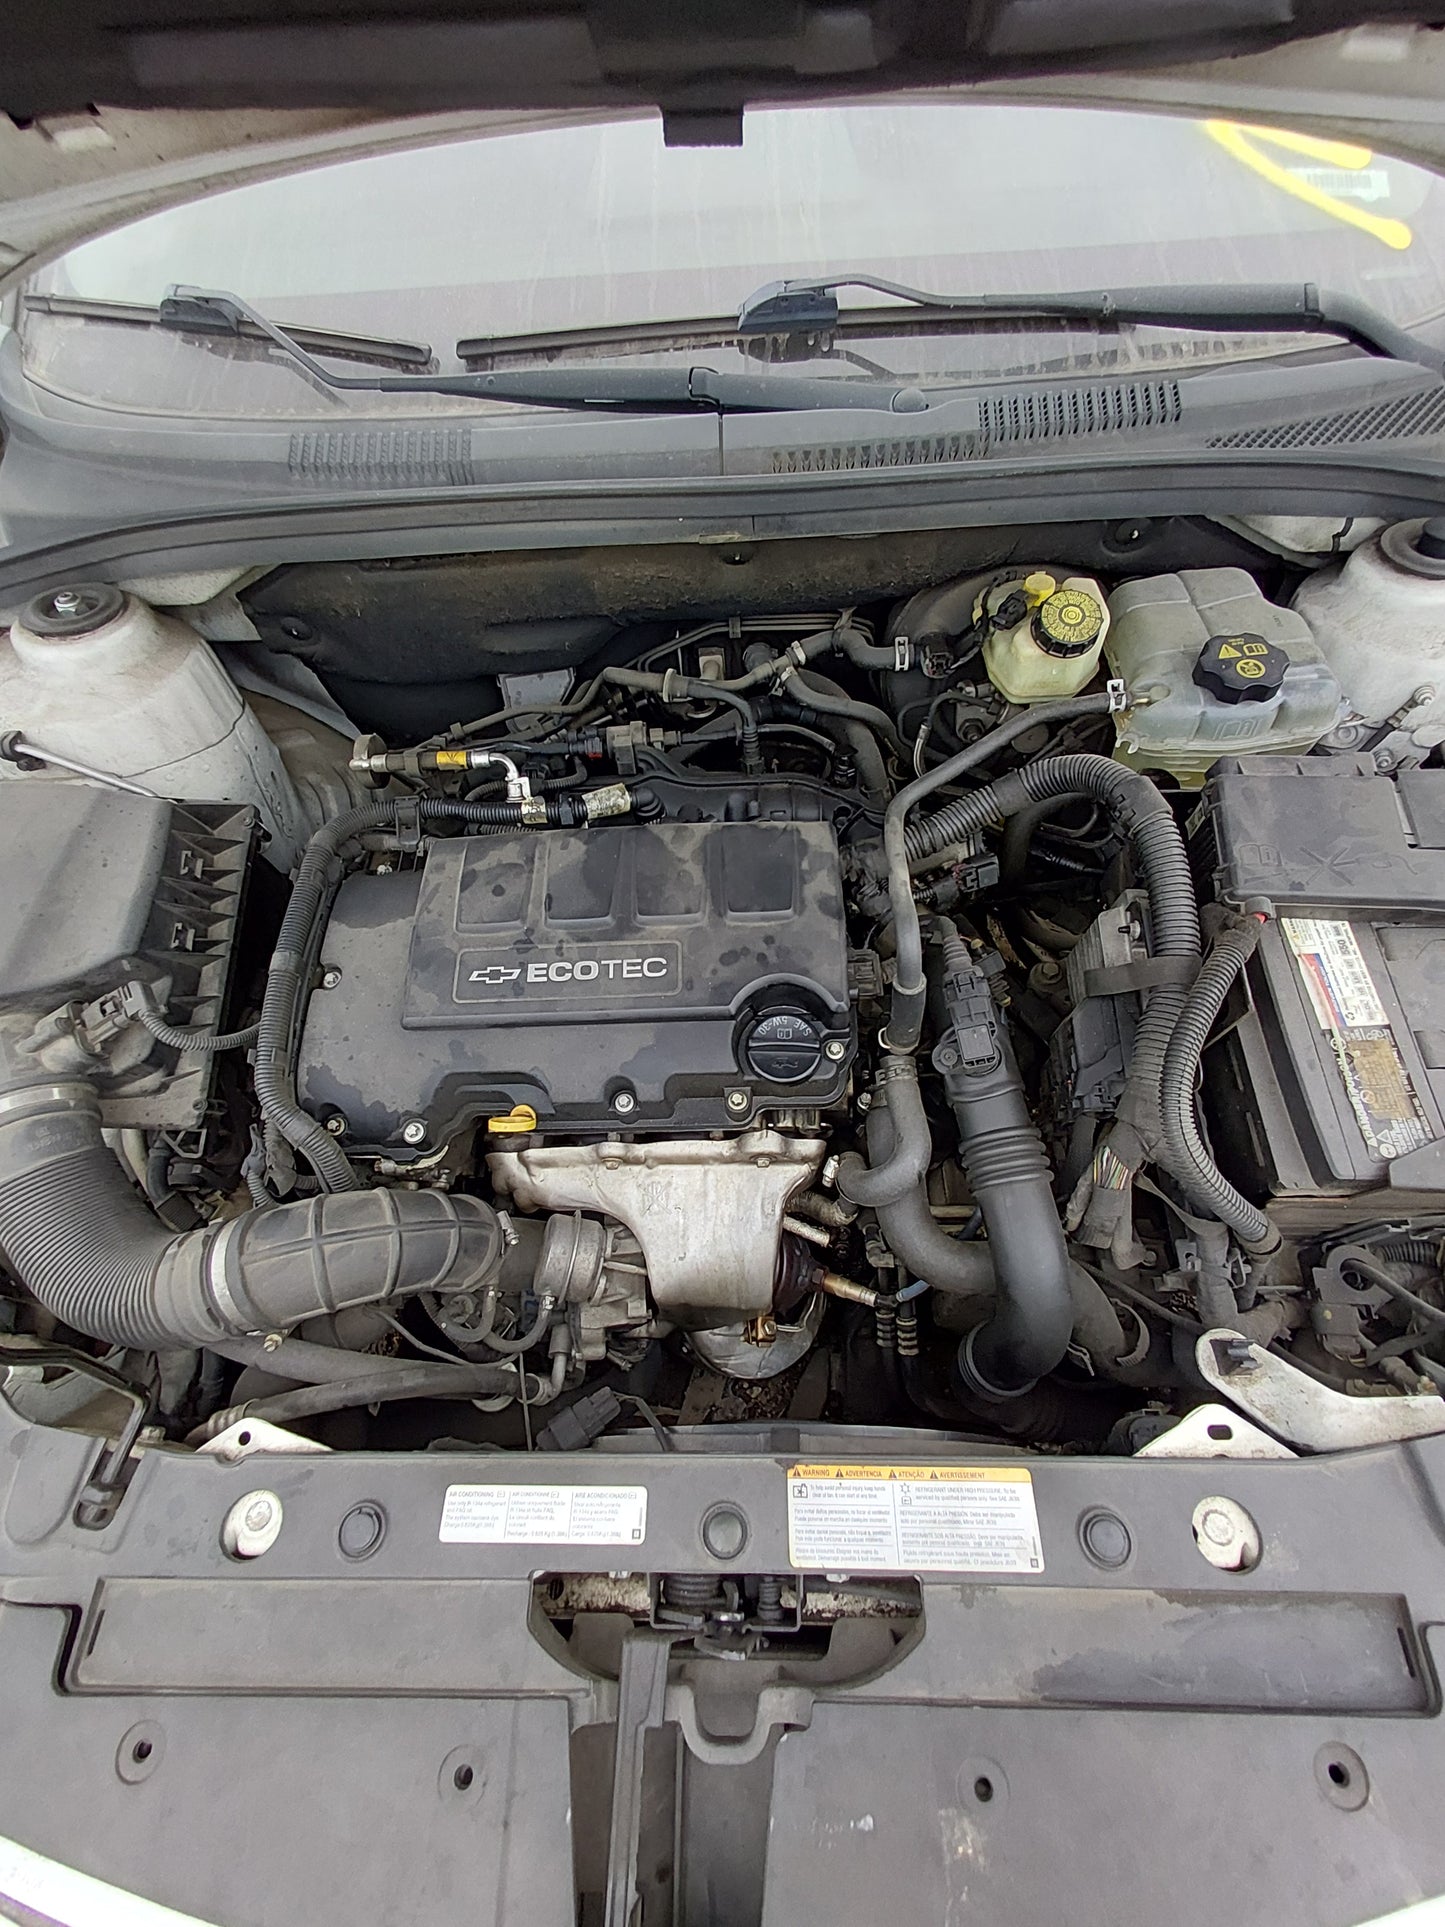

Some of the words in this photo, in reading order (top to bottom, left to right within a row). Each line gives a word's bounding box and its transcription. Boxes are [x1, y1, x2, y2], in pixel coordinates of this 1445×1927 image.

[1337, 939, 1350, 955] 550
[526, 957, 668, 984] ECOTEC
[758, 1016, 788, 1036] 5W-30
[793, 1018, 813, 1036] SAE
[898, 1470, 924, 1479] ATENÇÃO
